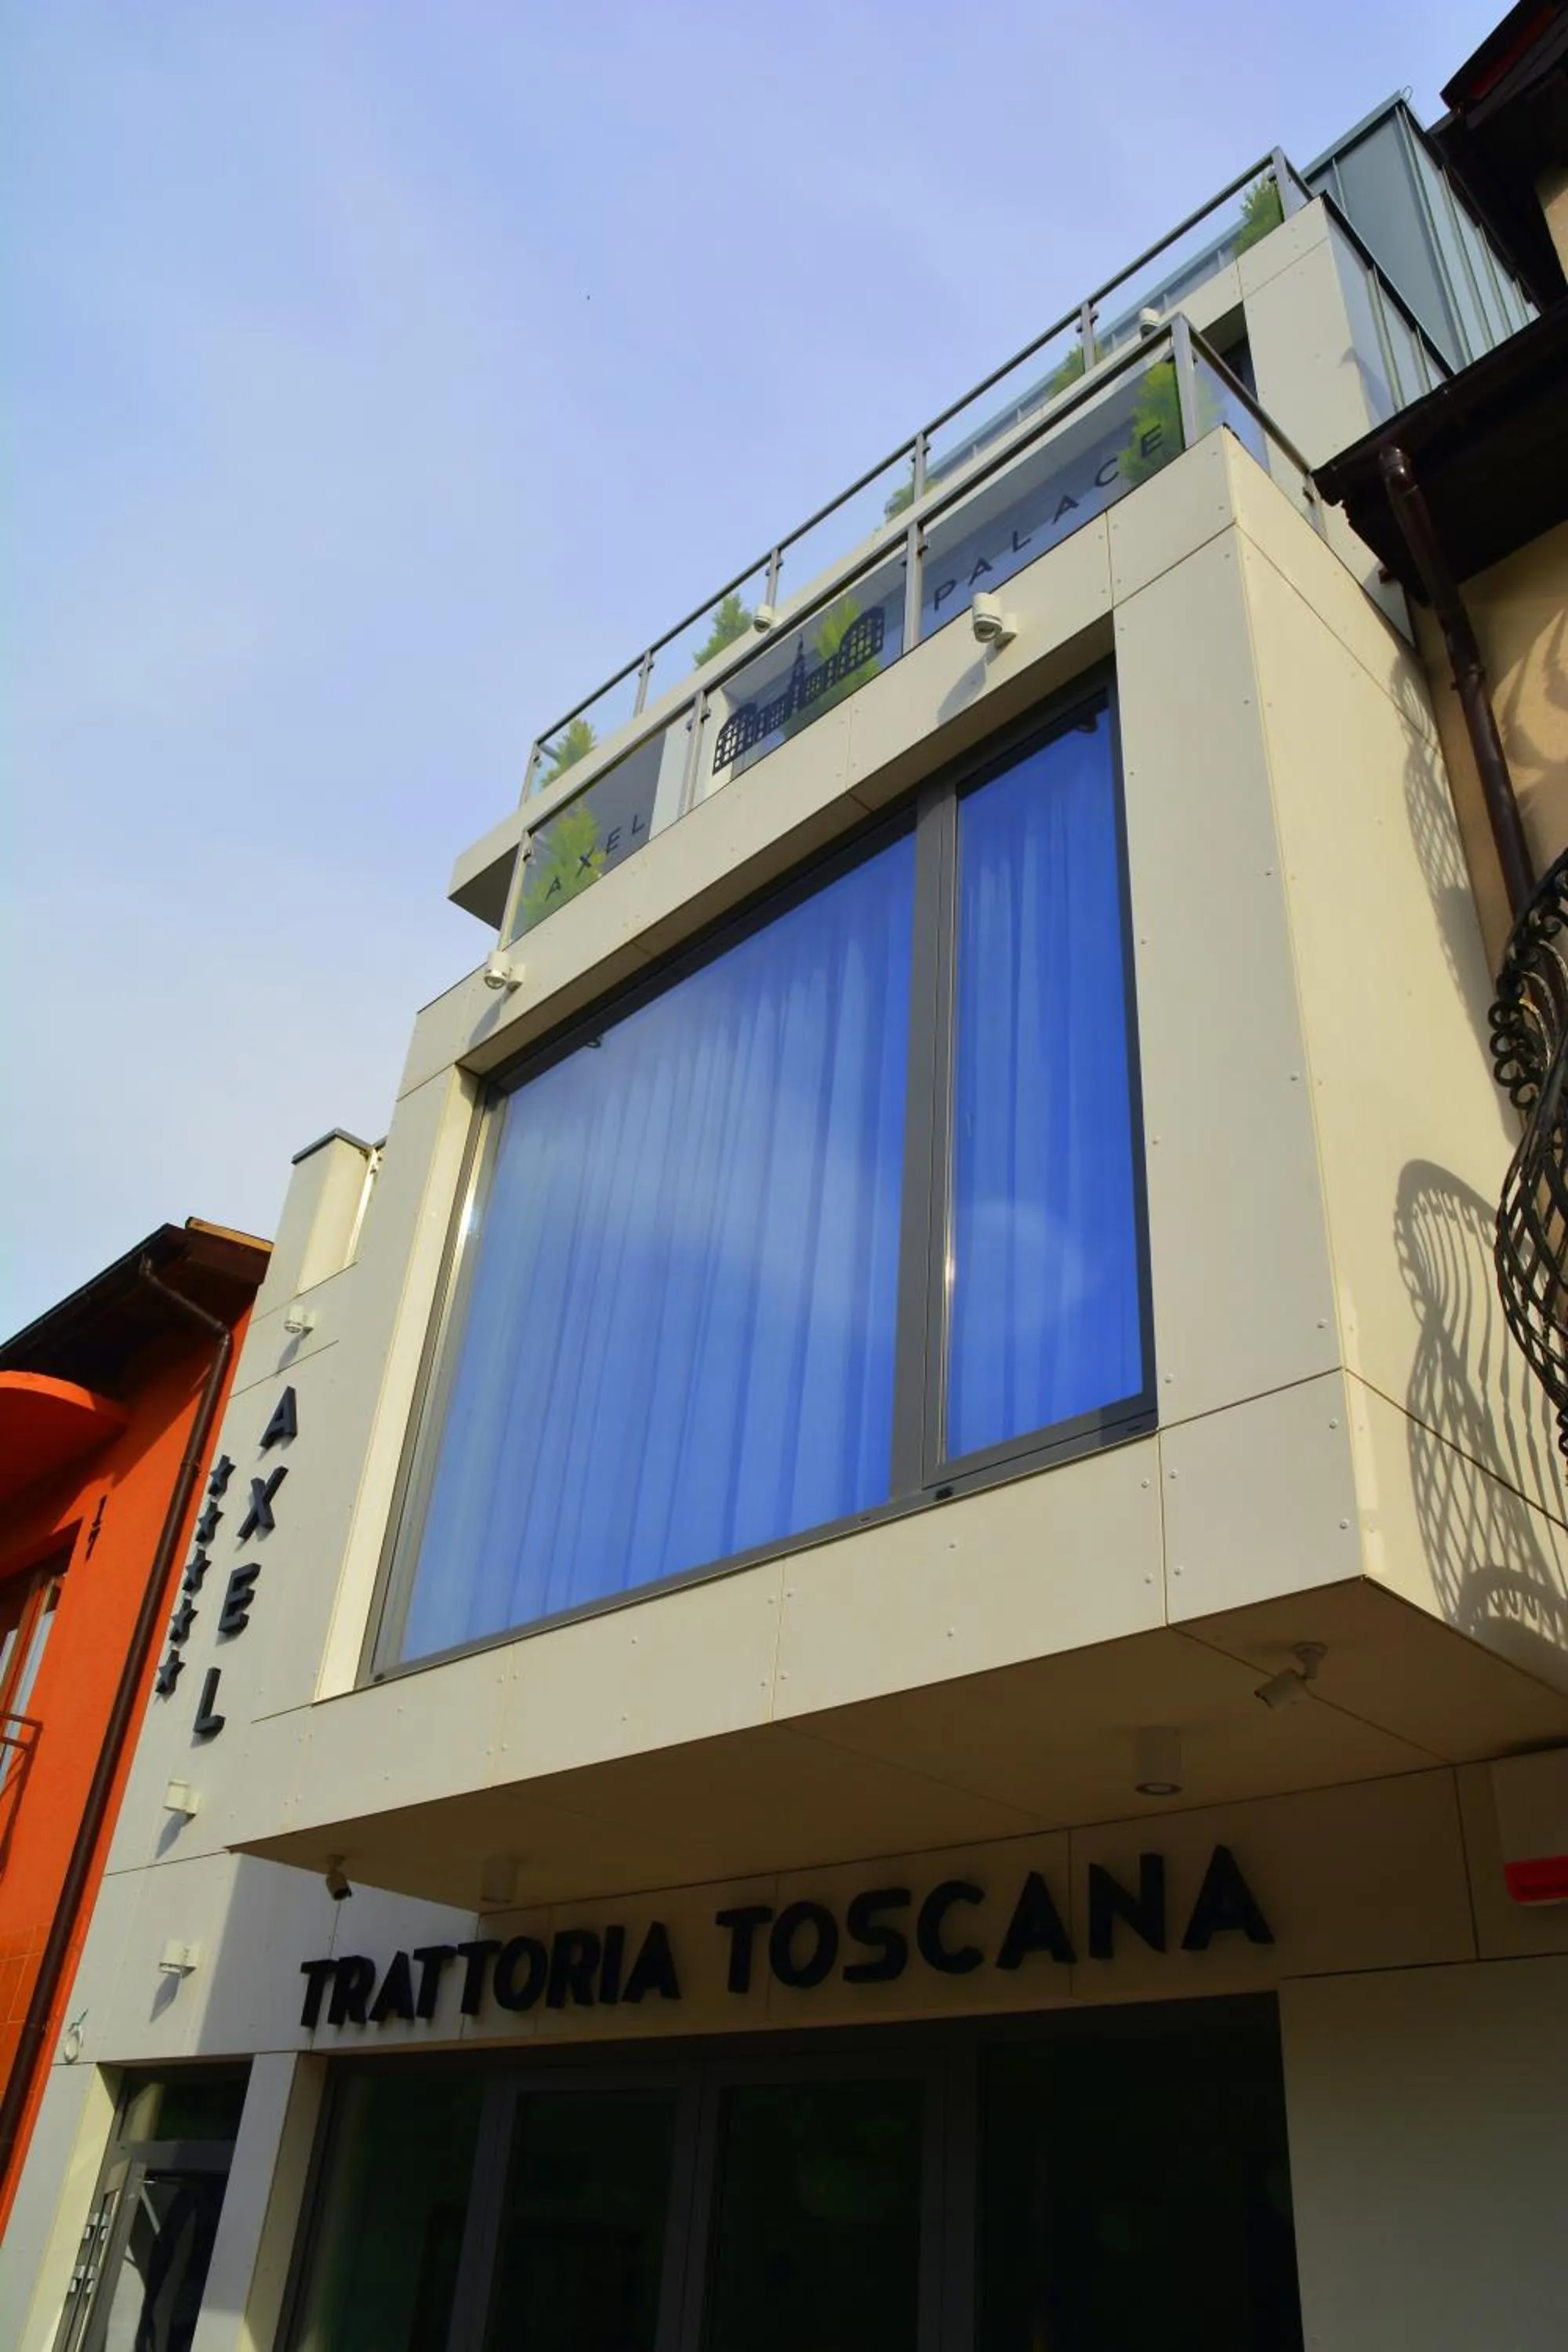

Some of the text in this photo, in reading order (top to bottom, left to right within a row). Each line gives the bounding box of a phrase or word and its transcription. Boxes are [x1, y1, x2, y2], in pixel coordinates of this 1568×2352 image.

[545, 424, 1163, 901] AXEL PALACE
[193, 1386, 298, 1734] AXEL
[300, 1844, 1276, 2027] TRATTORIA TOSCANA
